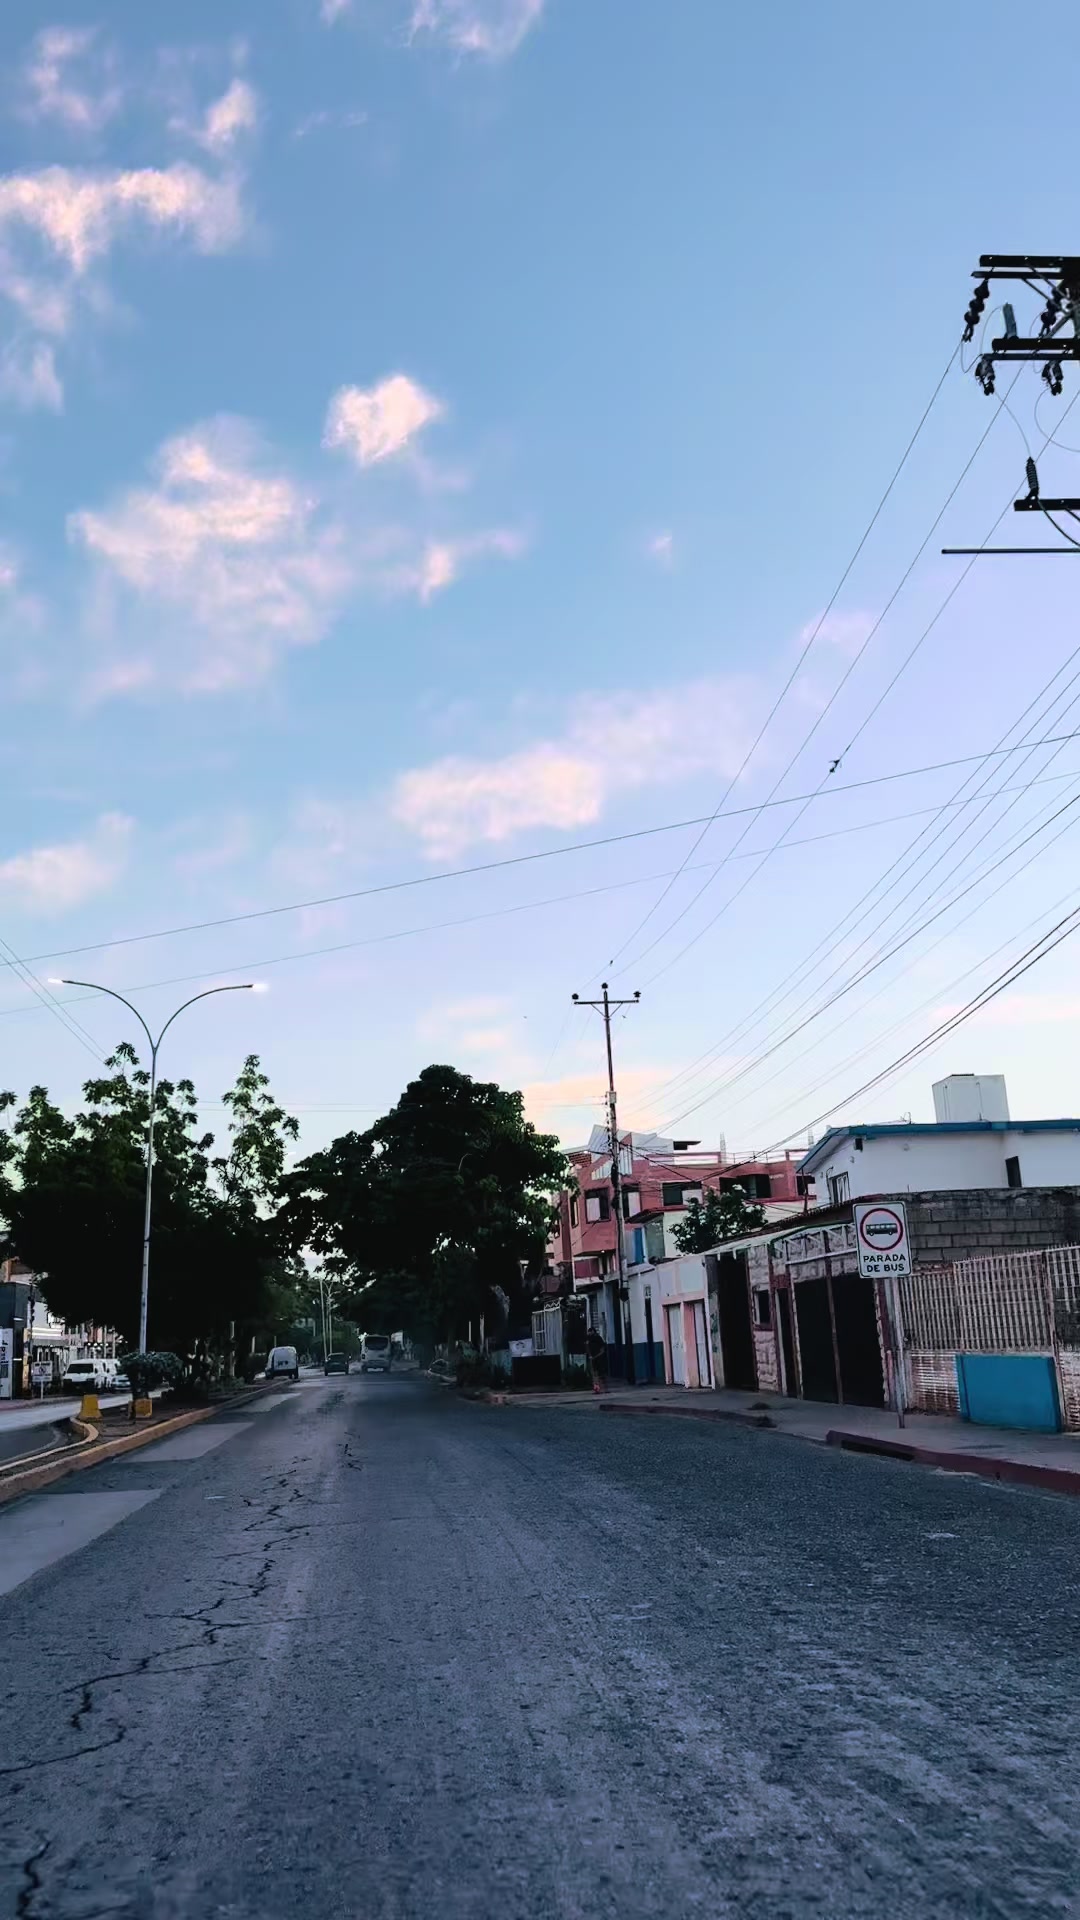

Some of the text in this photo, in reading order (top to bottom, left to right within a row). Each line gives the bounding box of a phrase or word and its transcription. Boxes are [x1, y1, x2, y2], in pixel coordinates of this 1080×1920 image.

[863, 1253, 906, 1263] PARADA
[867, 1263, 905, 1273] DE BUS
